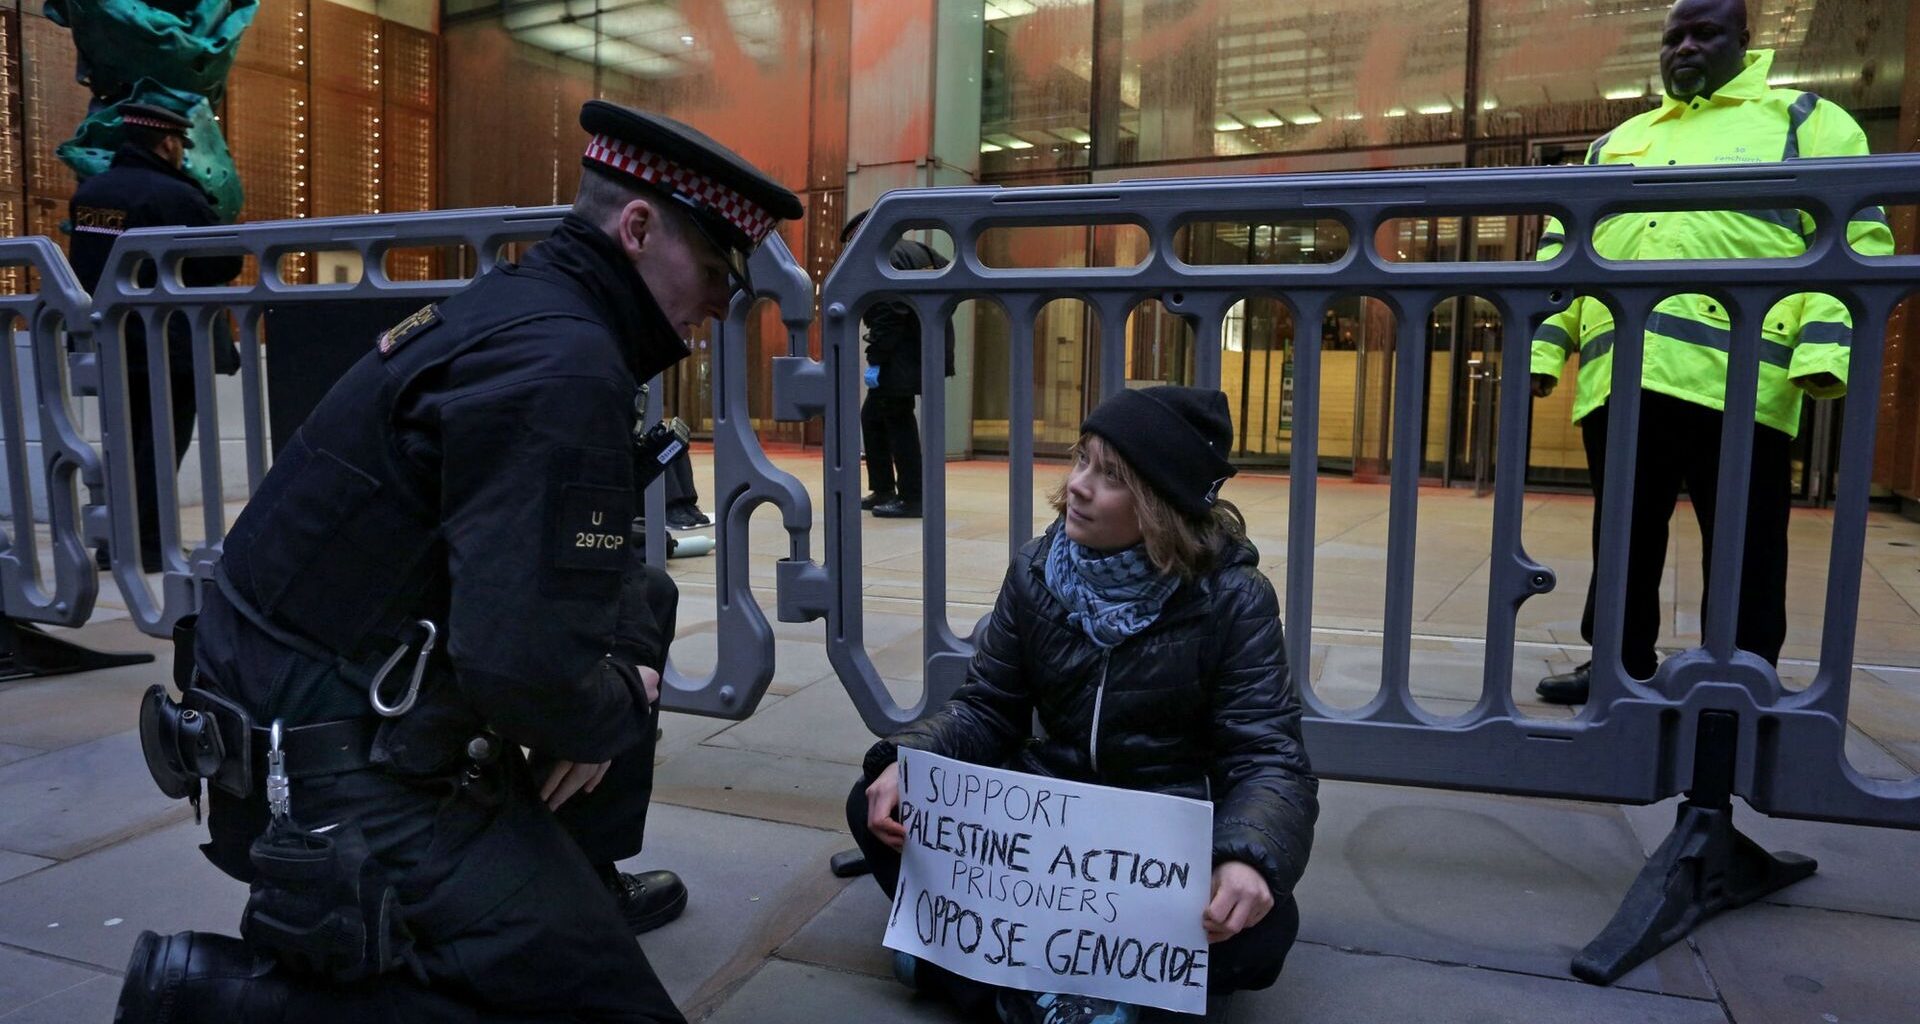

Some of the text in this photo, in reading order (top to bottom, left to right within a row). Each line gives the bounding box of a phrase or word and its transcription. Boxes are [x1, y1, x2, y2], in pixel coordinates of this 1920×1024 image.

[575, 532, 624, 550] 297CP
[591, 511, 602, 525] U
[926, 766, 1080, 827] SUPPORT
[900, 801, 1190, 889] PALESTINE ACTION
[951, 859, 1120, 923] PRISONERS
[915, 890, 1028, 967] OPPOSE
[1045, 929, 1208, 987] GENOCIDE
